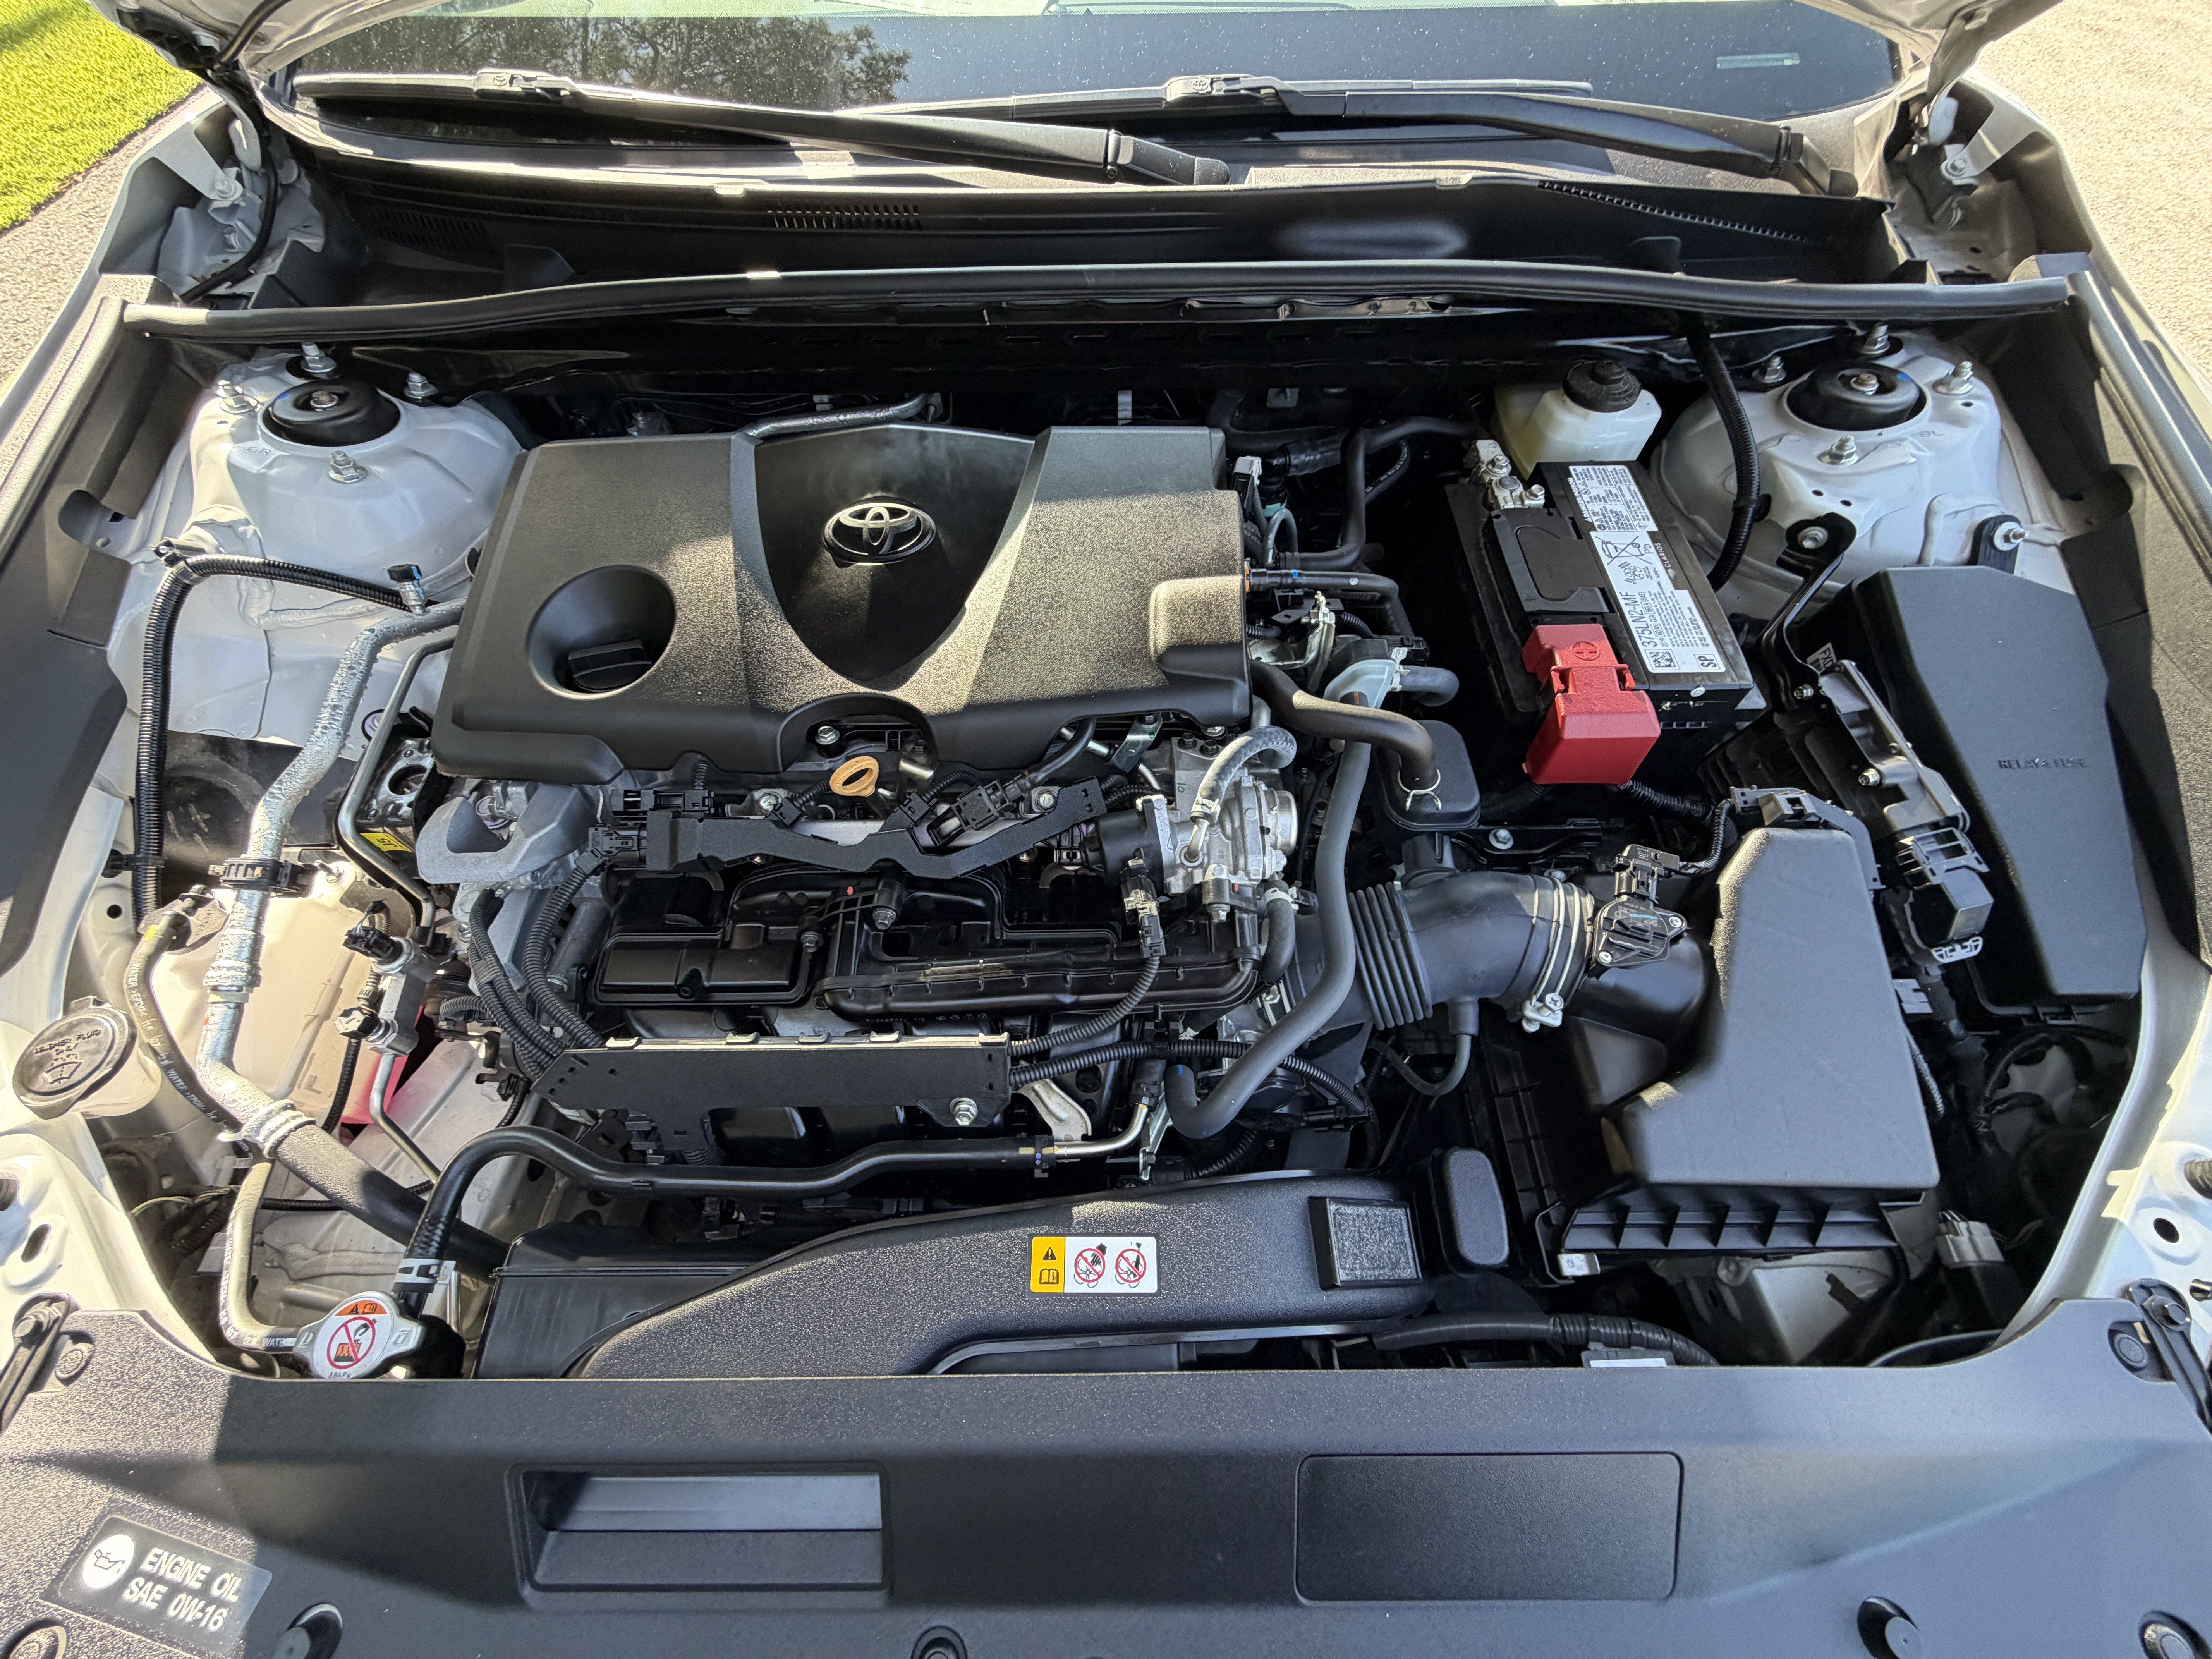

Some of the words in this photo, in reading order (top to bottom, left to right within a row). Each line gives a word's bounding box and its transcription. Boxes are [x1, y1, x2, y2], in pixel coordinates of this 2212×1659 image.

[1642, 544, 1654, 554] Pb
[1654, 543, 1671, 568] CLARIOS
[1619, 591, 1657, 647] 375LN2-MF
[1698, 656, 1717, 668] SP
[1998, 758, 2039, 769] RELAY
[128, 963, 142, 988] WATER
[167, 1068, 188, 1092] WATER
[139, 1547, 212, 1589] ENGINE
[211, 1573, 242, 1602] OIL
[124, 1577, 168, 1609] SAE
[167, 1592, 229, 1633] 0W-16
